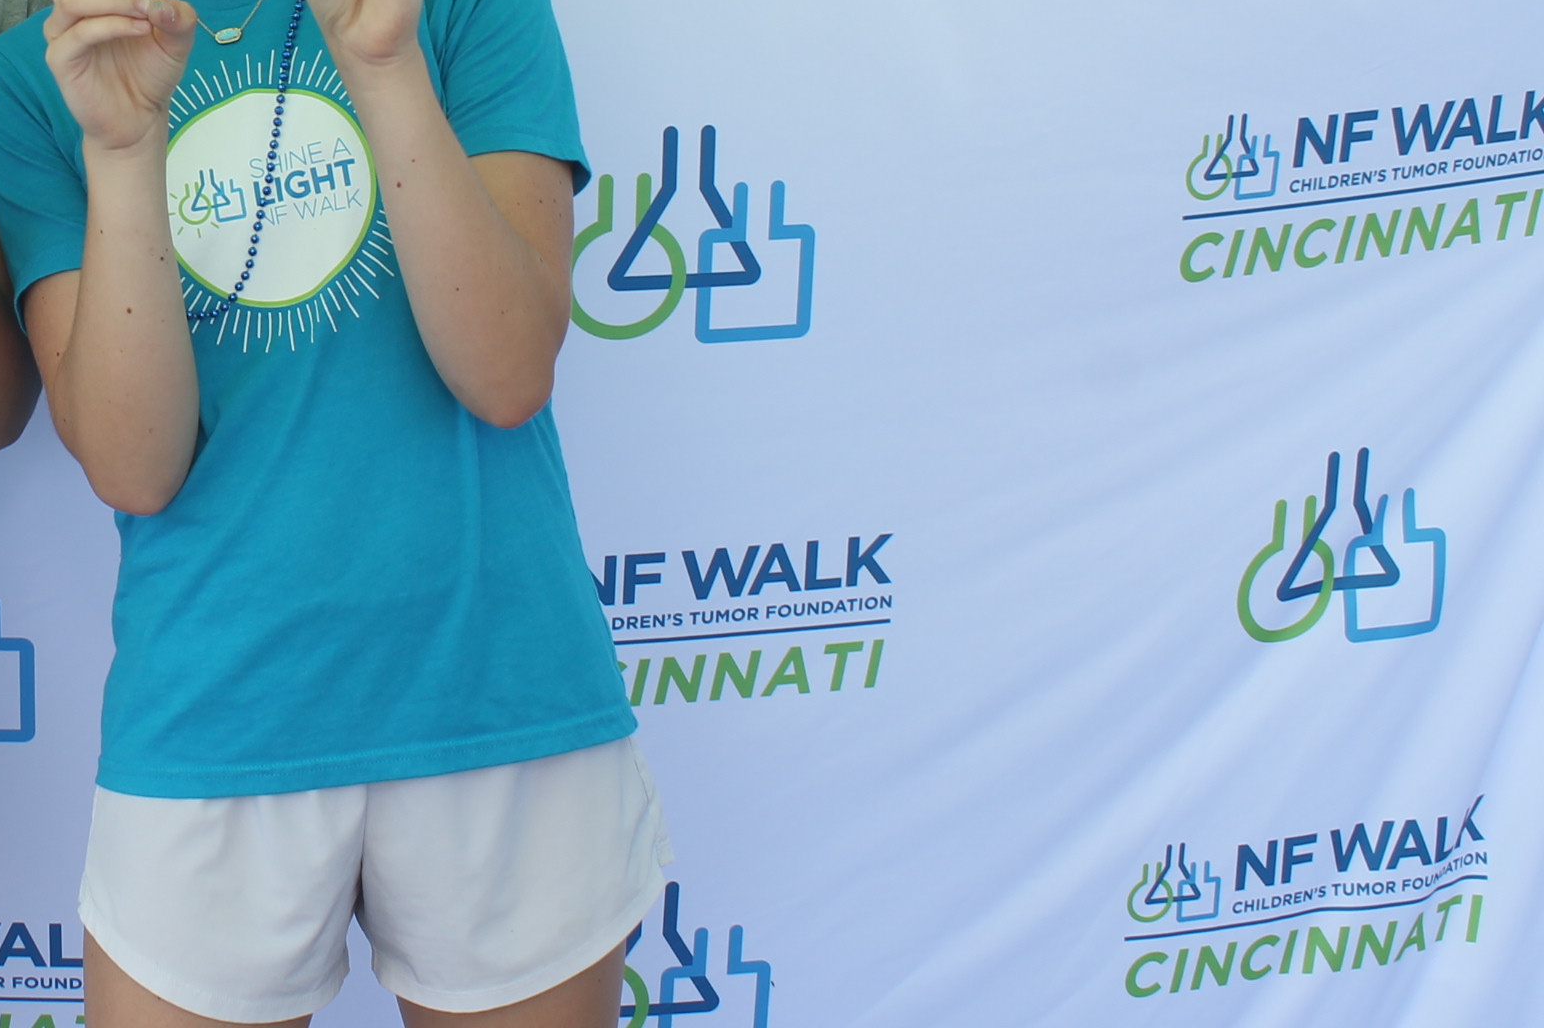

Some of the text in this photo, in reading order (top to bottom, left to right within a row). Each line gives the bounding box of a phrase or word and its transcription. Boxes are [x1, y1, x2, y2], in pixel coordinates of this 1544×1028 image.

[249, 137, 352, 178] SHINE A
[1292, 90, 1544, 168] NF WALK
[253, 158, 356, 206] LIGHT
[1289, 148, 1544, 194] CHILDREN'S TUMOR FOUNDATIO
[293, 189, 363, 219] WALK
[1179, 188, 1544, 283] CINCINNATI
[681, 533, 893, 601] WALK
[689, 607, 759, 626] TUMOR
[765, 595, 893, 619] FOUNDATION
[618, 639, 885, 707] INNATI
[1234, 794, 1485, 891] NF WALK
[1232, 885, 1327, 914] CHILDREN'S
[1332, 881, 1395, 897] TUMOR
[1125, 894, 1483, 998] CINCINNATI
